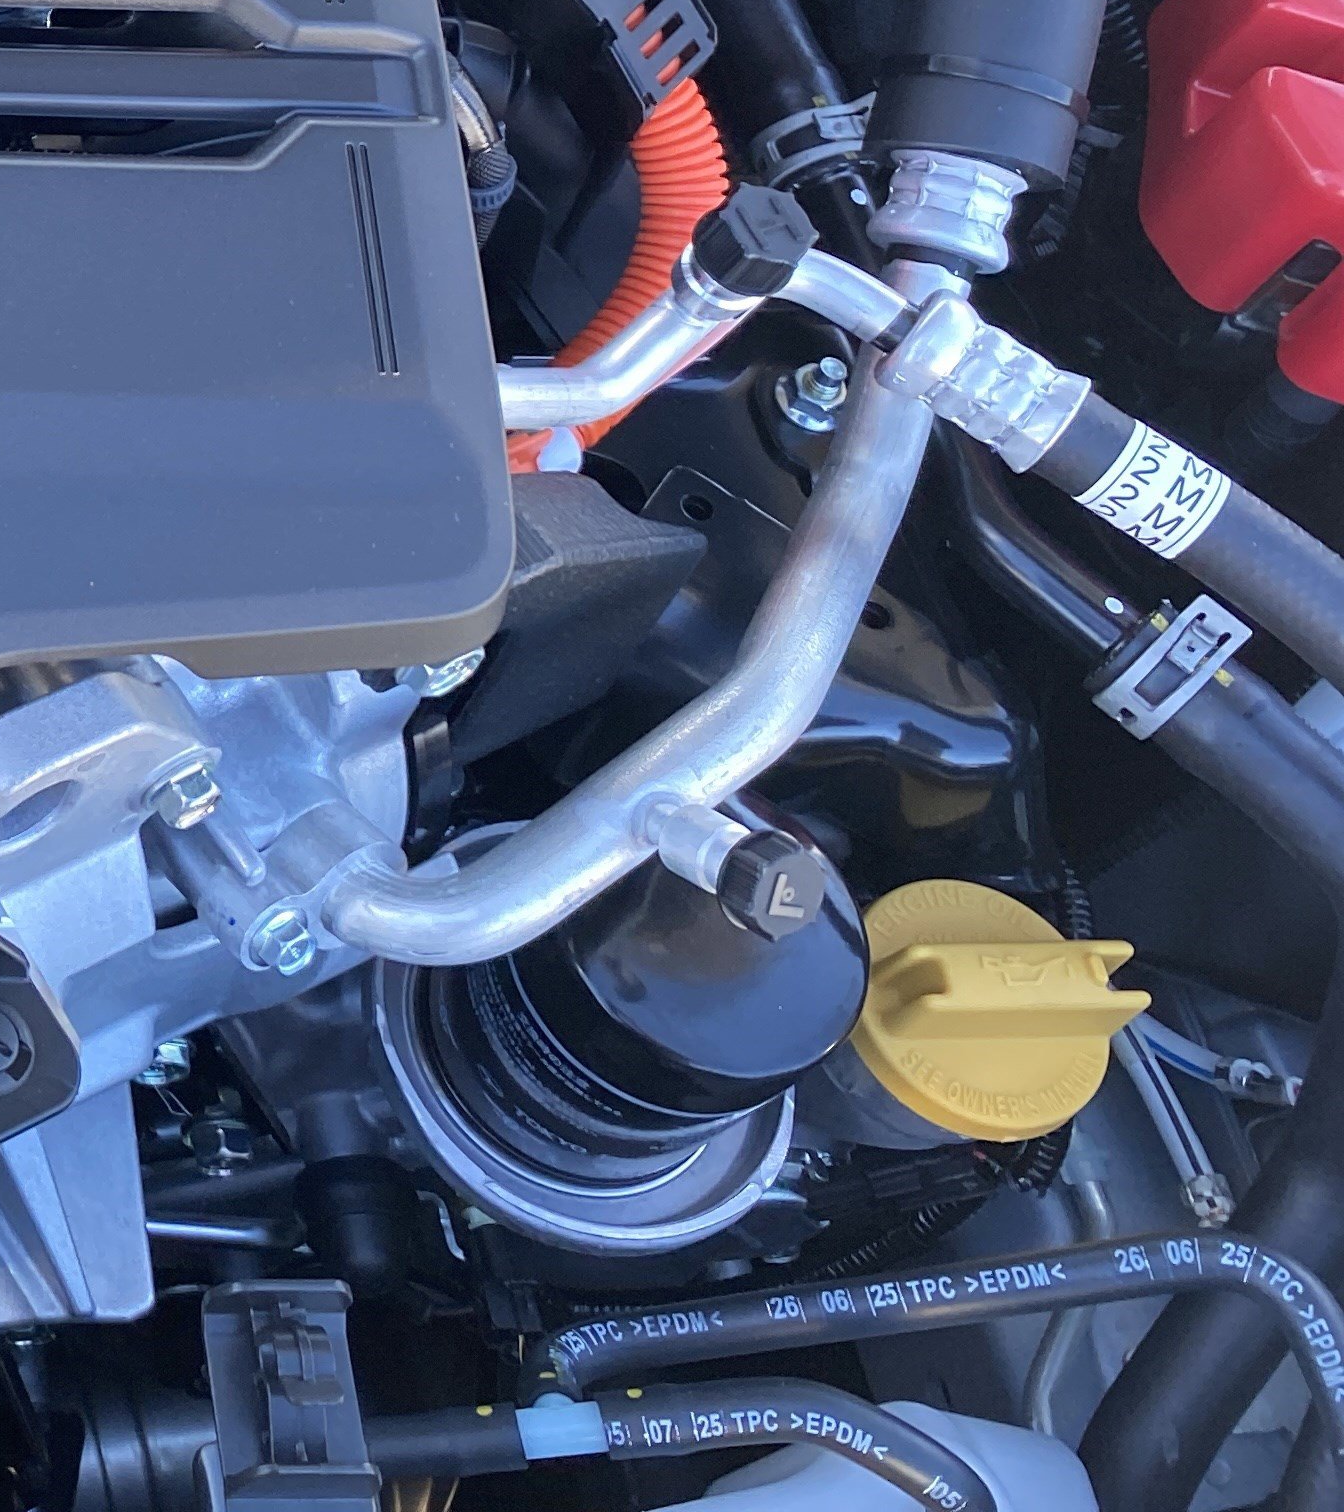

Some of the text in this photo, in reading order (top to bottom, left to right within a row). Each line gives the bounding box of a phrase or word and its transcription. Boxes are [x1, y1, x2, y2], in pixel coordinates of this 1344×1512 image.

[872, 884, 975, 940] ENGINE
[901, 1049, 944, 1091] SEE
[946, 1079, 1041, 1121] OWNER'S
[584, 1320, 623, 1348] TPC
[908, 1274, 957, 1304] TPC
[1258, 1255, 1305, 1303] TPC
[730, 1408, 780, 1435] TPC
